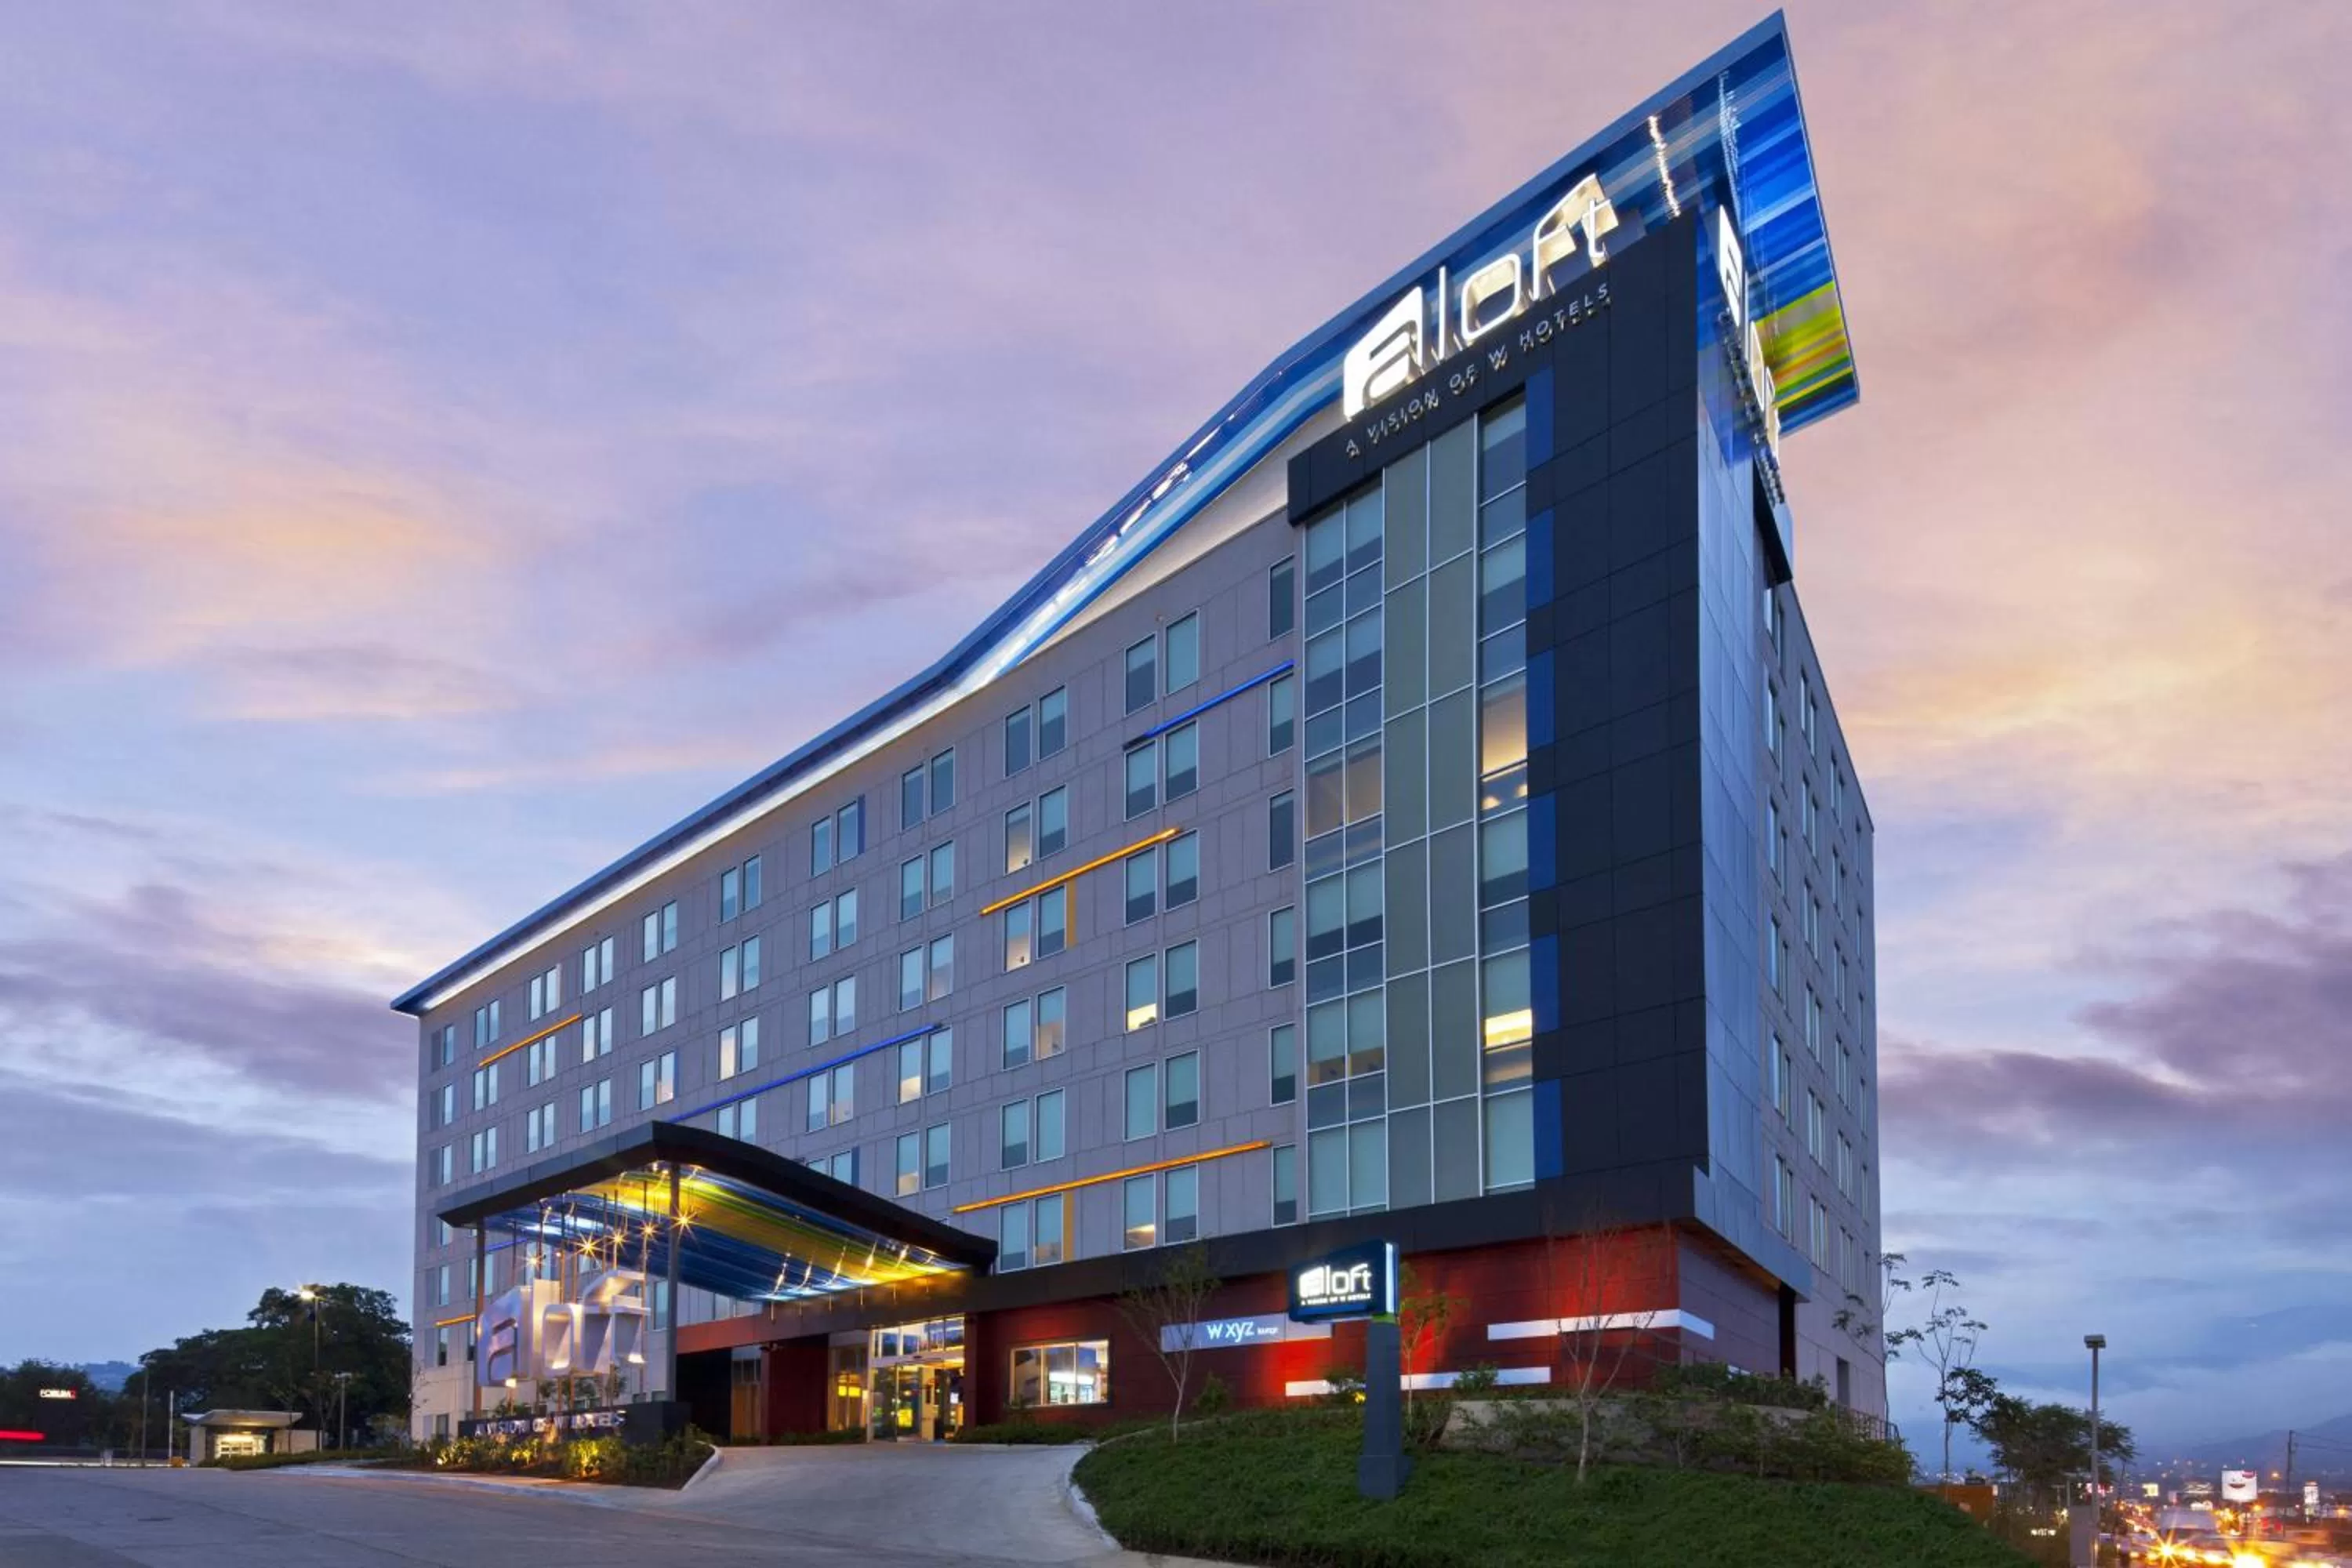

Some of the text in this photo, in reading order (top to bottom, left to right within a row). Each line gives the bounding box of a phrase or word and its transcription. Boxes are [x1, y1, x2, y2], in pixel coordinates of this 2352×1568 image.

[1343, 172, 1618, 423] aloft
[1345, 283, 1610, 456] A VISION OF W HOTELS
[476, 1268, 651, 1386] aloft
[1299, 1263, 1372, 1298] aloft
